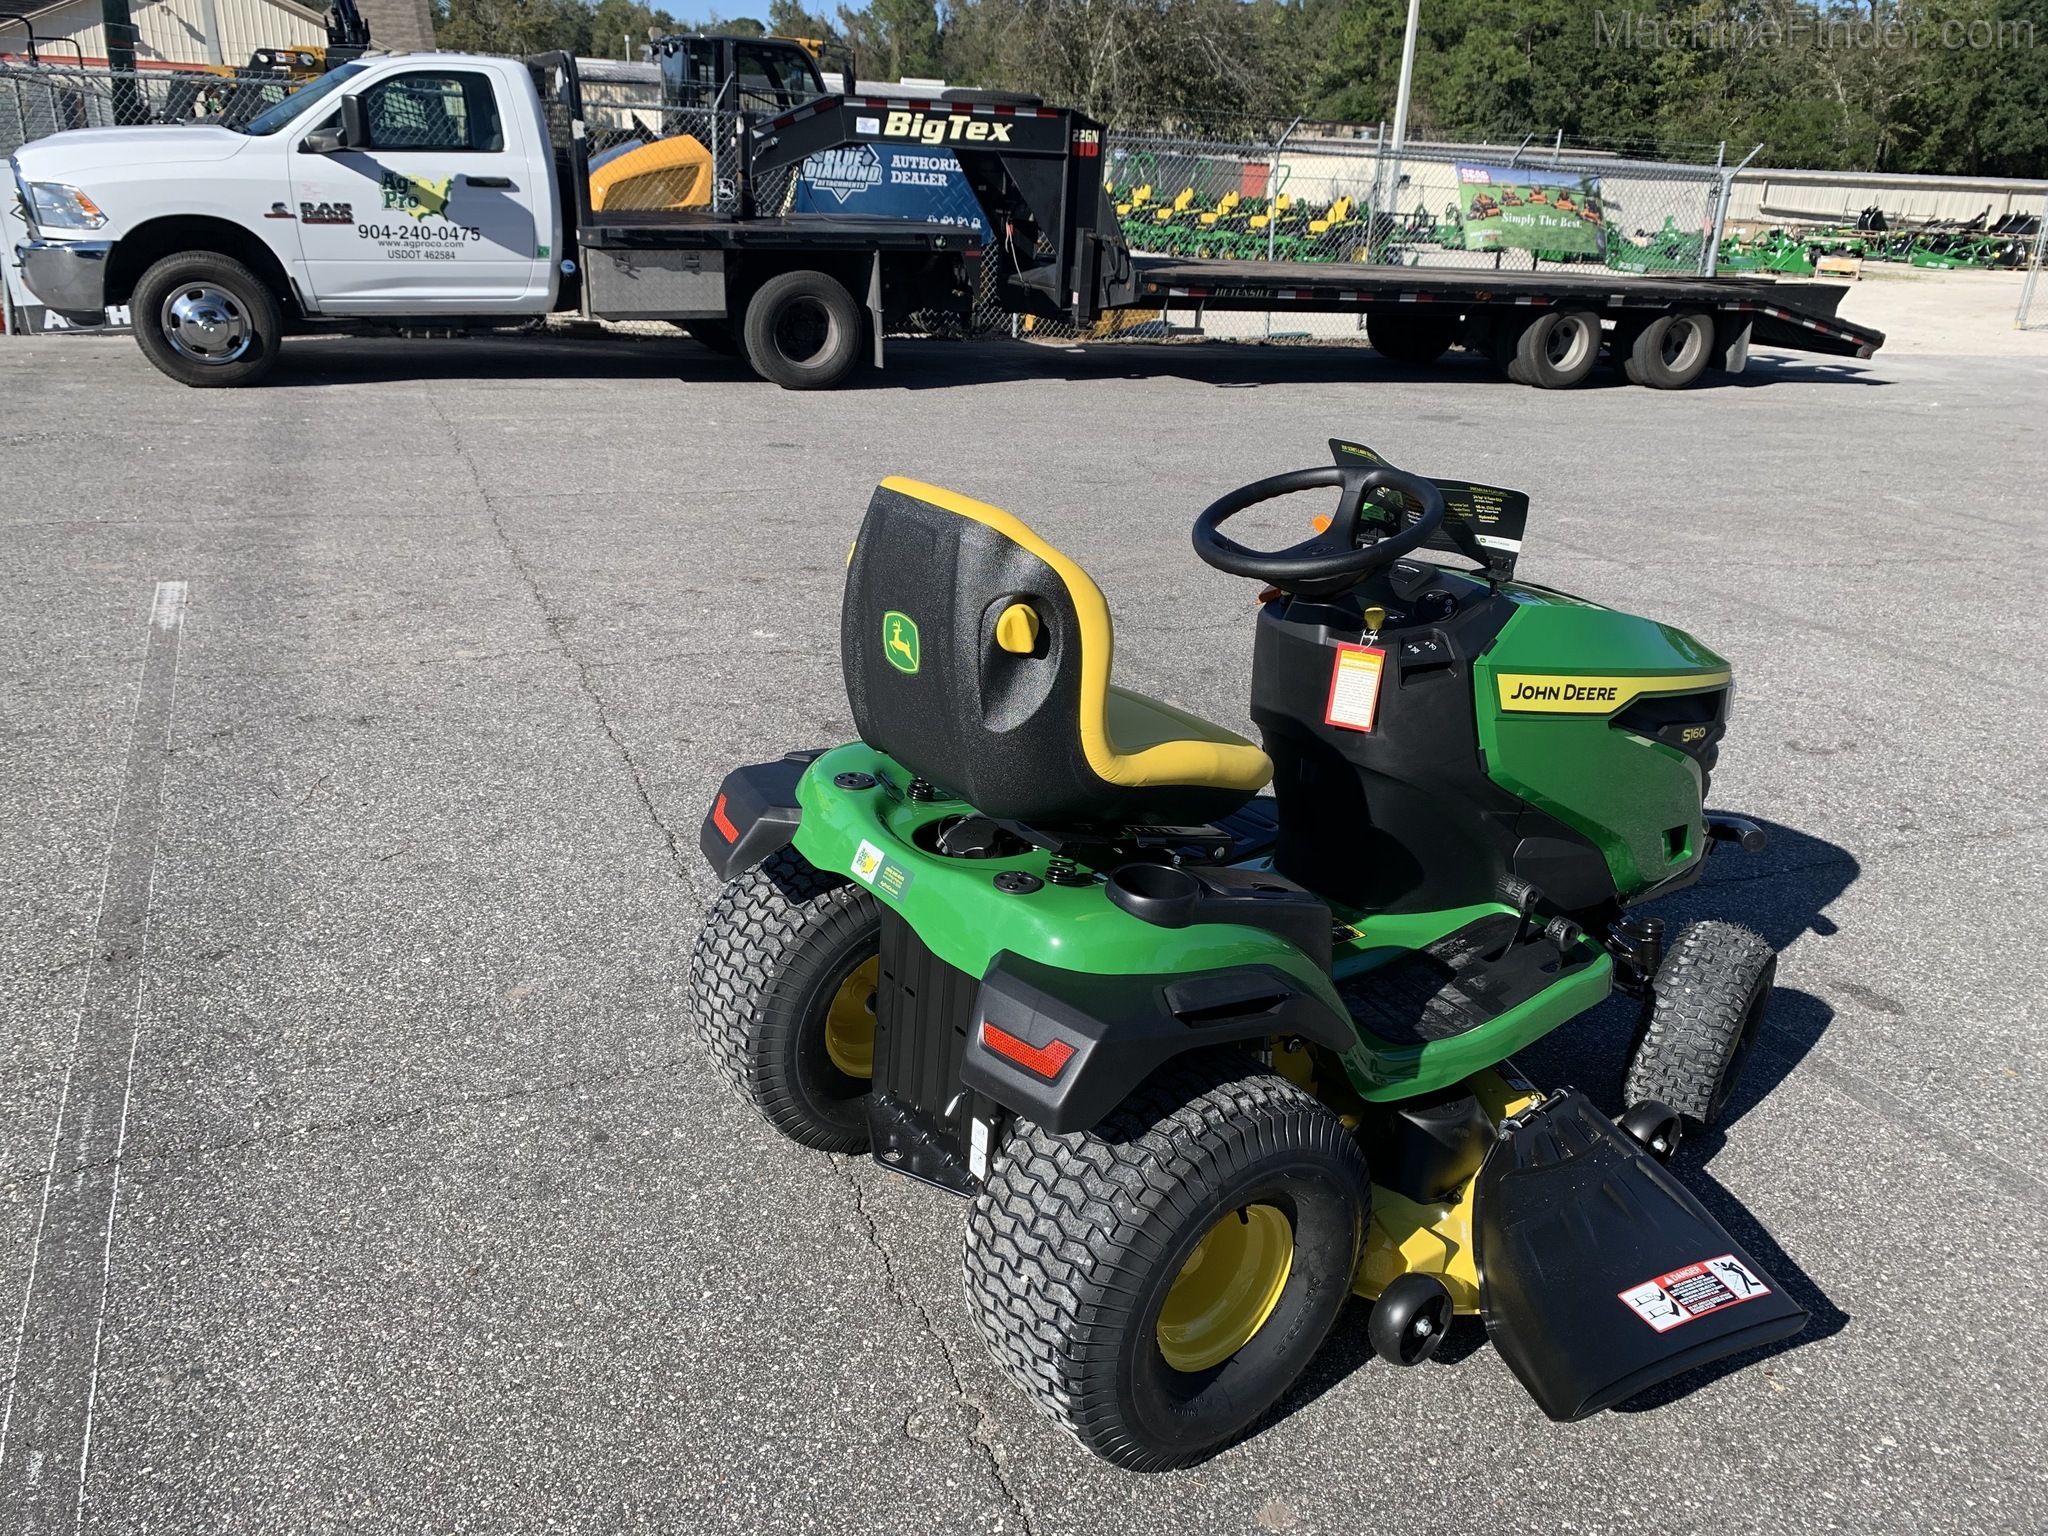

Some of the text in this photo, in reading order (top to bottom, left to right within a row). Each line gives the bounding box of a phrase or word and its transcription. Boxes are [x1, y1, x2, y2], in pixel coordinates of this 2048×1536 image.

[884, 111, 1013, 144] BigTex
[1072, 128, 1099, 144] 22GN
[823, 150, 862, 165] BLUE
[805, 162, 880, 181] DIAMOND
[890, 171, 948, 187] DEALER
[816, 180, 866, 189] ATTACHMENTS
[383, 190, 421, 210] Pro
[1502, 212, 1583, 229] Simply The Best.
[358, 224, 480, 241] 904-240-0475
[378, 239, 464, 249] www.agproco.com
[388, 250, 455, 260] USDOT 462584
[1510, 682, 1618, 701] JOHN DEERE
[1682, 727, 1706, 742] S160
[1672, 1265, 1703, 1282] DANGER
